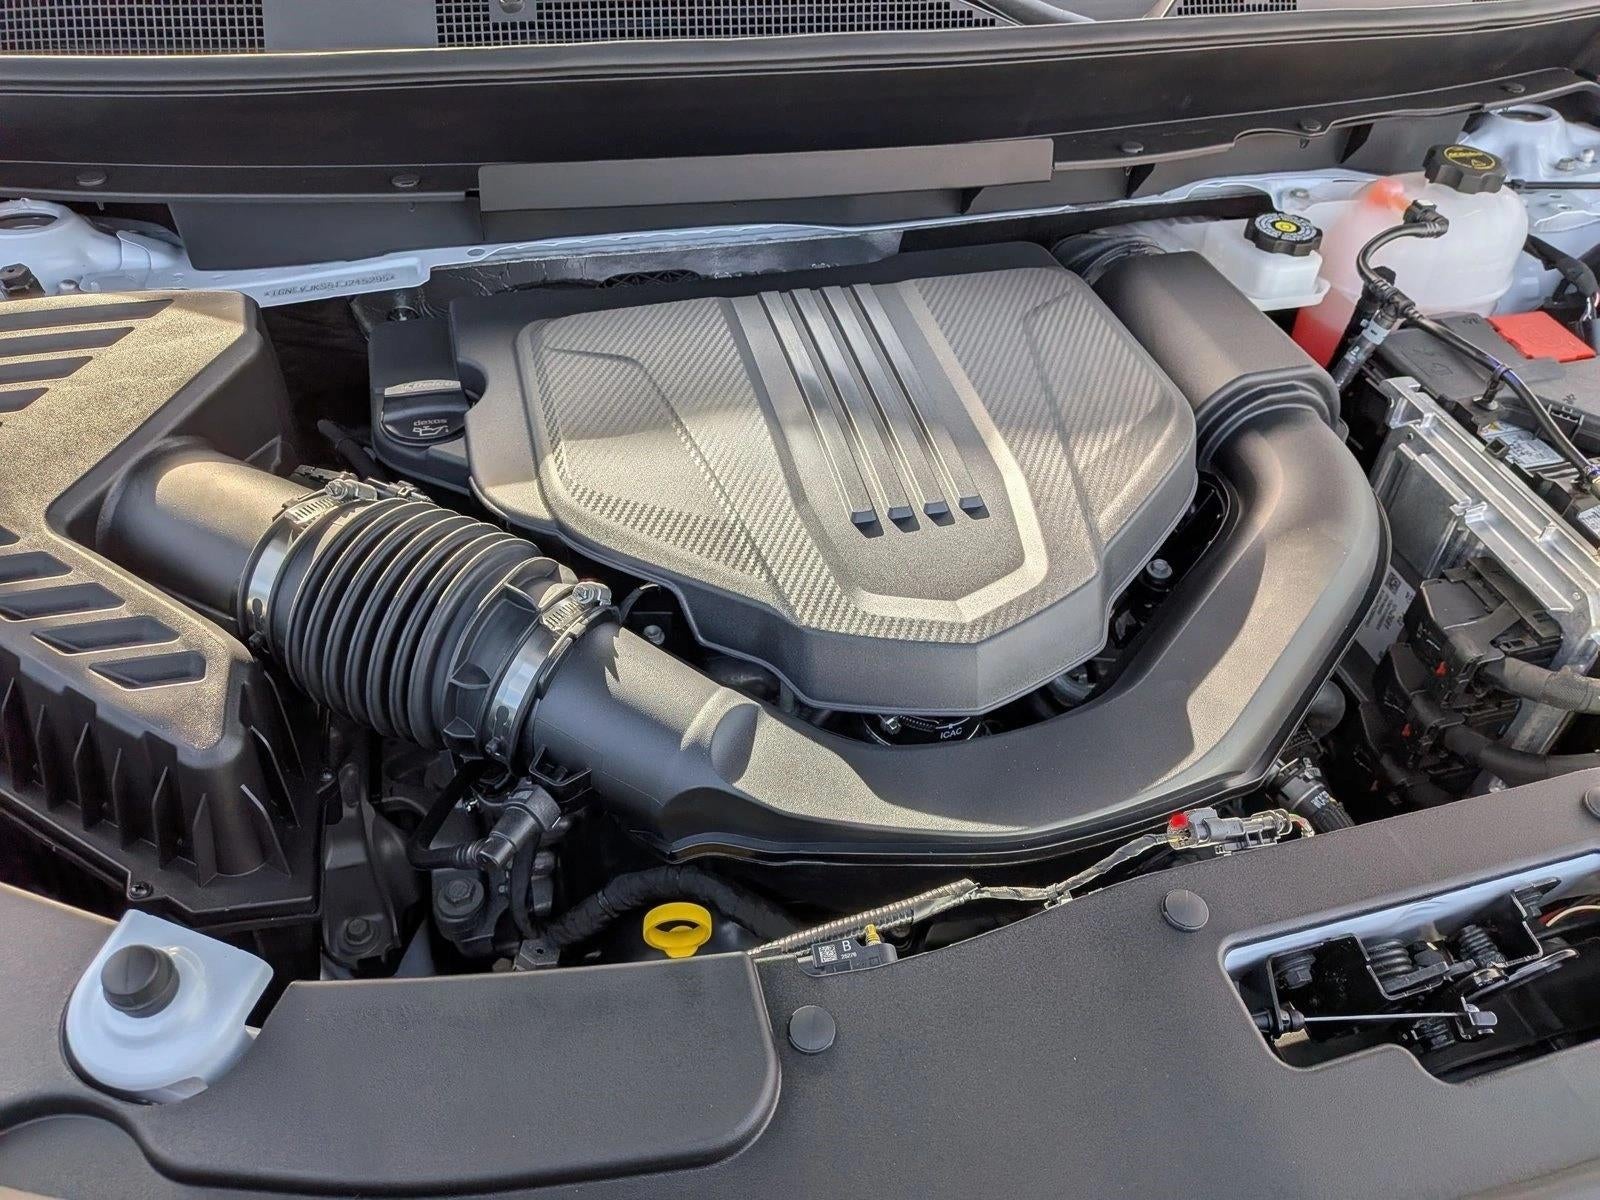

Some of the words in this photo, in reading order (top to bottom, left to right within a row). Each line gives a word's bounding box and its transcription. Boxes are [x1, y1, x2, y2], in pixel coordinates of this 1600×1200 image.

[413, 418, 447, 426] dexos
[940, 727, 963, 739] ICAC
[842, 940, 852, 952] B
